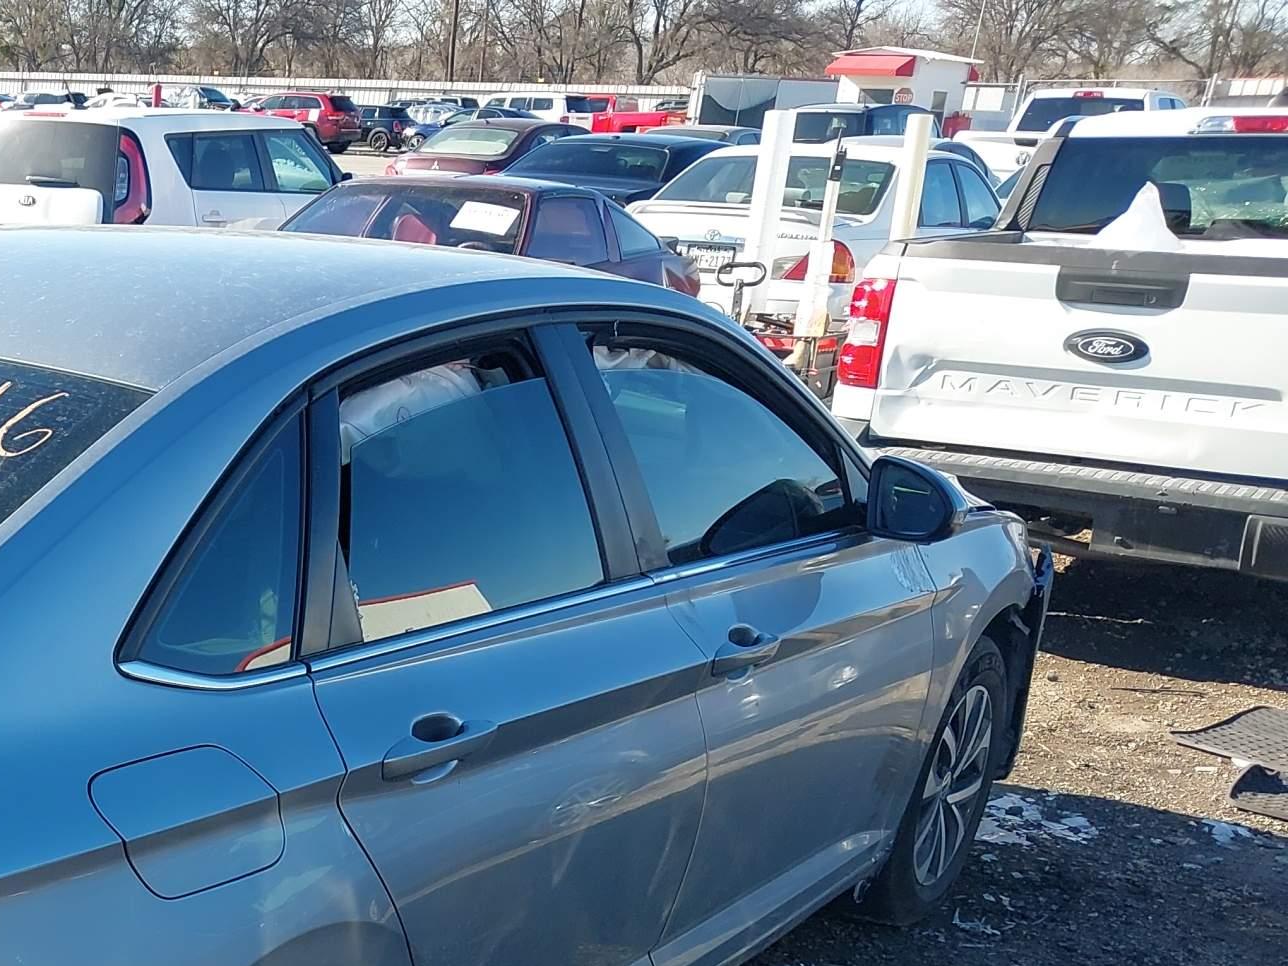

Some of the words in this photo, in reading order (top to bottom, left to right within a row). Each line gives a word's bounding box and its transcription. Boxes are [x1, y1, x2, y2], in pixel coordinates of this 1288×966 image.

[895, 93, 913, 102] STOP
[1086, 338, 1125, 357] Ford
[940, 373, 1266, 418] MAVERICK
